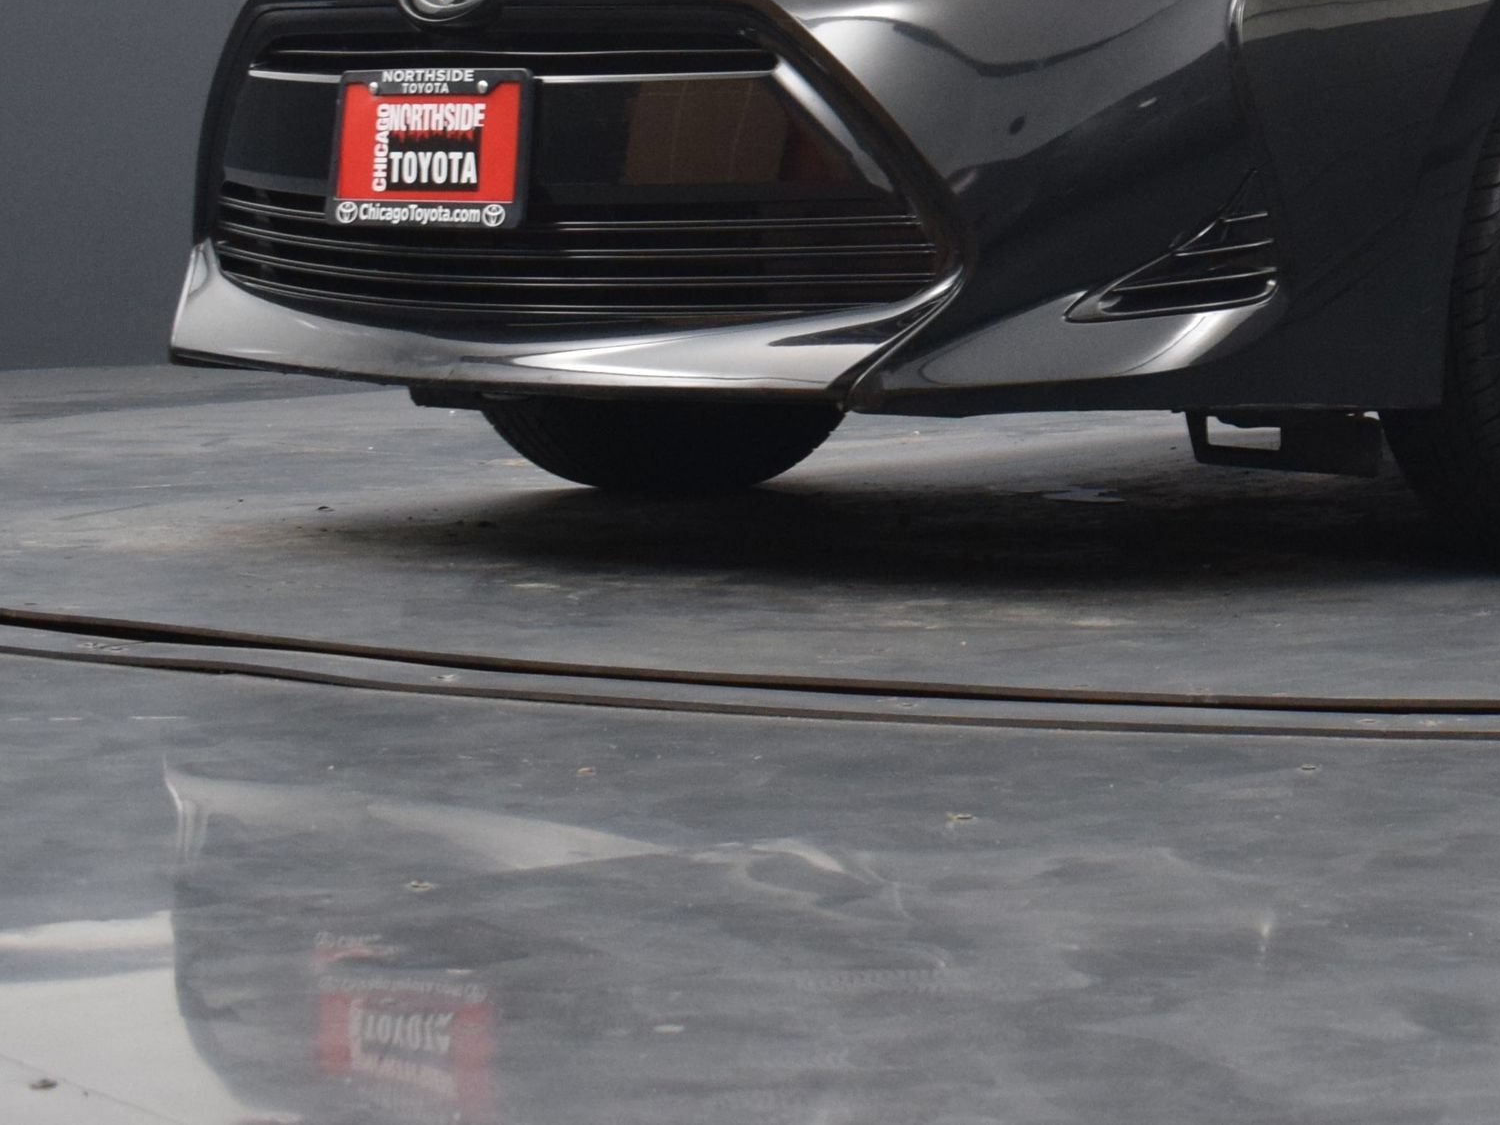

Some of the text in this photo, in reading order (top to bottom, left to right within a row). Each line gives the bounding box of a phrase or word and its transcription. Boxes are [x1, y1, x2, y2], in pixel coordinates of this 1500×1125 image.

[381, 69, 475, 83] NORTHSIDE
[401, 82, 450, 94] TOYOTA
[388, 103, 486, 132] NORTHSIDE
[372, 103, 390, 193] CHICAGO
[389, 151, 478, 185] TOYOTA
[358, 203, 481, 225] ChicagoToyota.com
